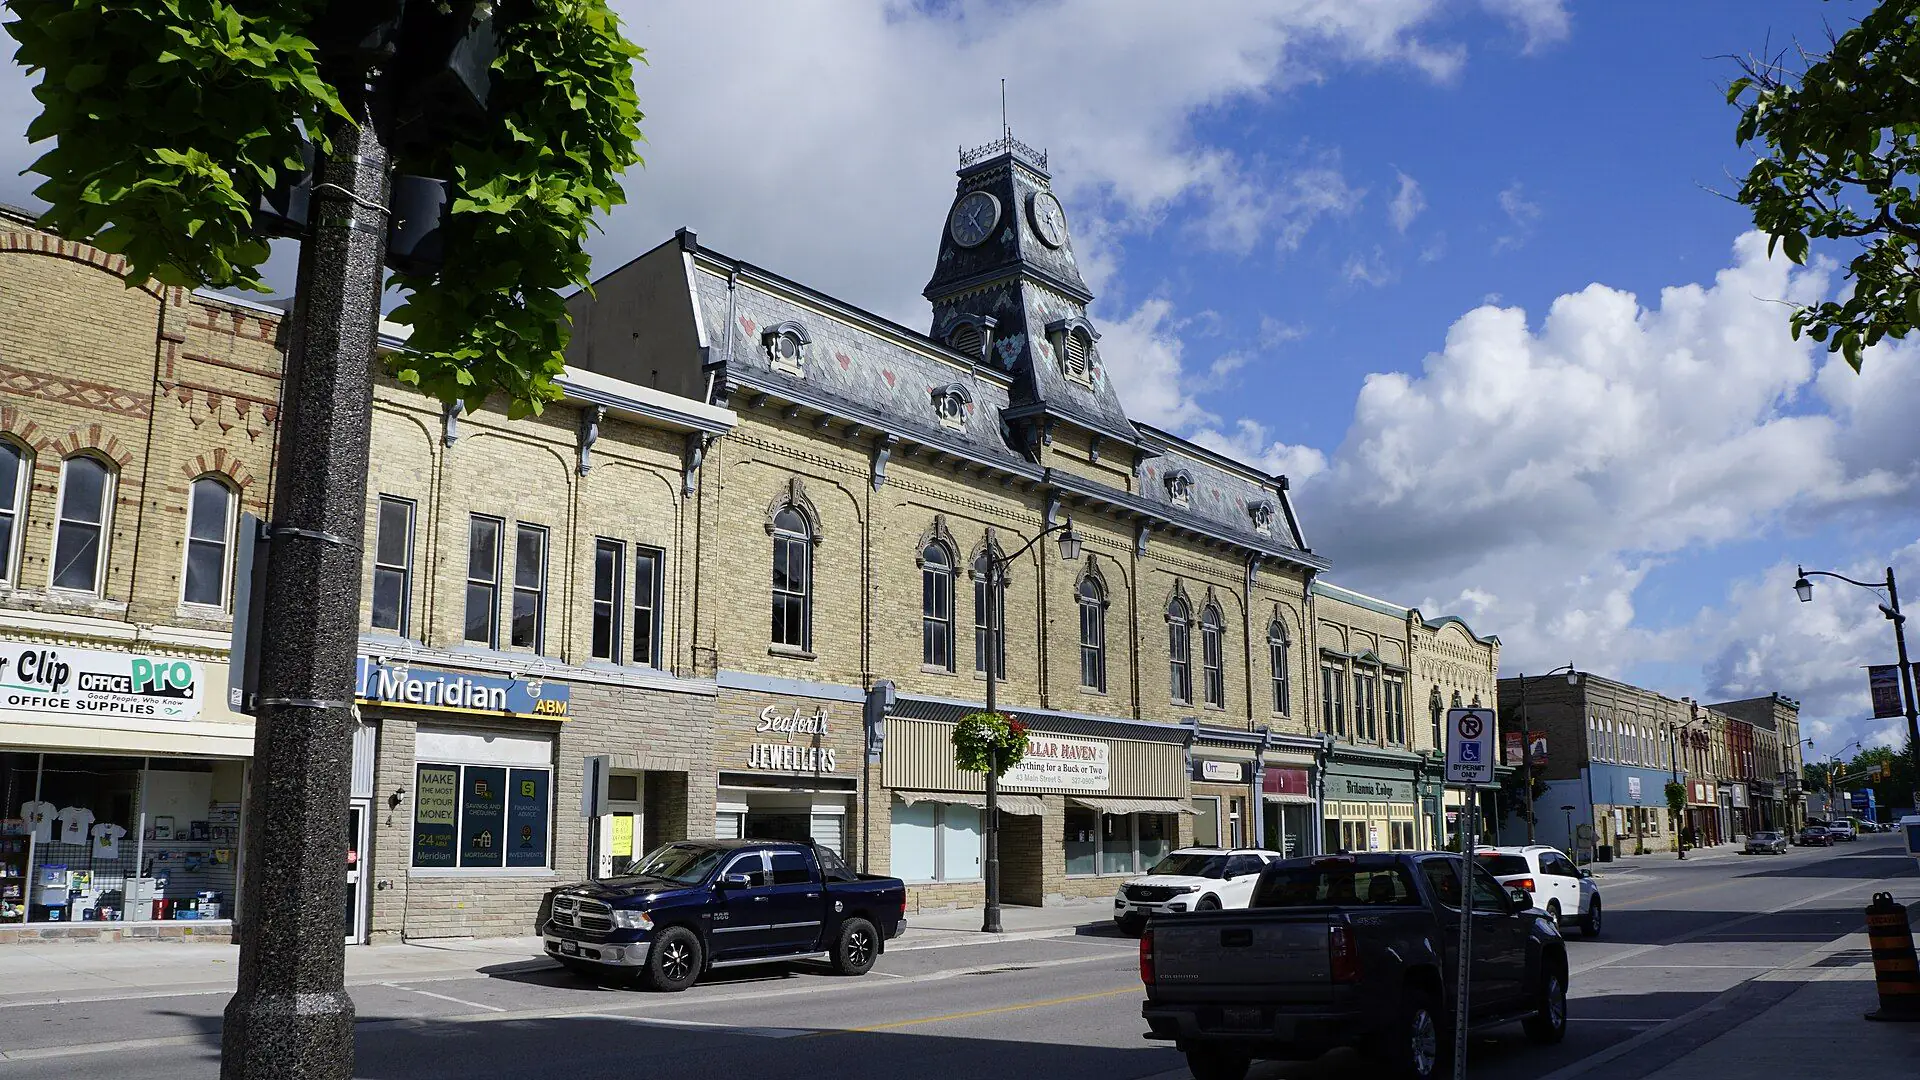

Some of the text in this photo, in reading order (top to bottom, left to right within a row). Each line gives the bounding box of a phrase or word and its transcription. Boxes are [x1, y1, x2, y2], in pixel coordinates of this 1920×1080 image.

[17, 650, 70, 692] Clip
[131, 658, 192, 692] Pro
[81, 674, 130, 692] OFFICE
[378, 669, 507, 710] Meridian
[87, 692, 109, 700] Good
[112, 694, 140, 703] People,
[8, 695, 155, 715] OFFICE SUPPLIES
[535, 699, 567, 714] ABM
[756, 705, 829, 743] Seaforth
[748, 743, 836, 772] JEWELLERS
[1024, 741, 1058, 758] OLLAR
[1061, 744, 1097, 761] HAVEN
[1012, 762, 1045, 773] erything
[1046, 763, 1056, 771] for
[1063, 764, 1079, 773] Buck
[1089, 765, 1103, 775] Two
[1205, 761, 1218, 773] Orr
[1453, 763, 1485, 772] BY PERMIT
[422, 774, 454, 785] MAKE
[1024, 774, 1039, 782] Main
[1039, 775, 1057, 783] Street
[421, 786, 453, 795] THE MOST
[1346, 780, 1374, 795] Britannia
[1375, 782, 1393, 799] Lodge
[420, 797, 453, 806] OF YOUR
[420, 809, 453, 819] MONEY.
[418, 833, 434, 846] 24
[417, 851, 451, 860] Meridian
